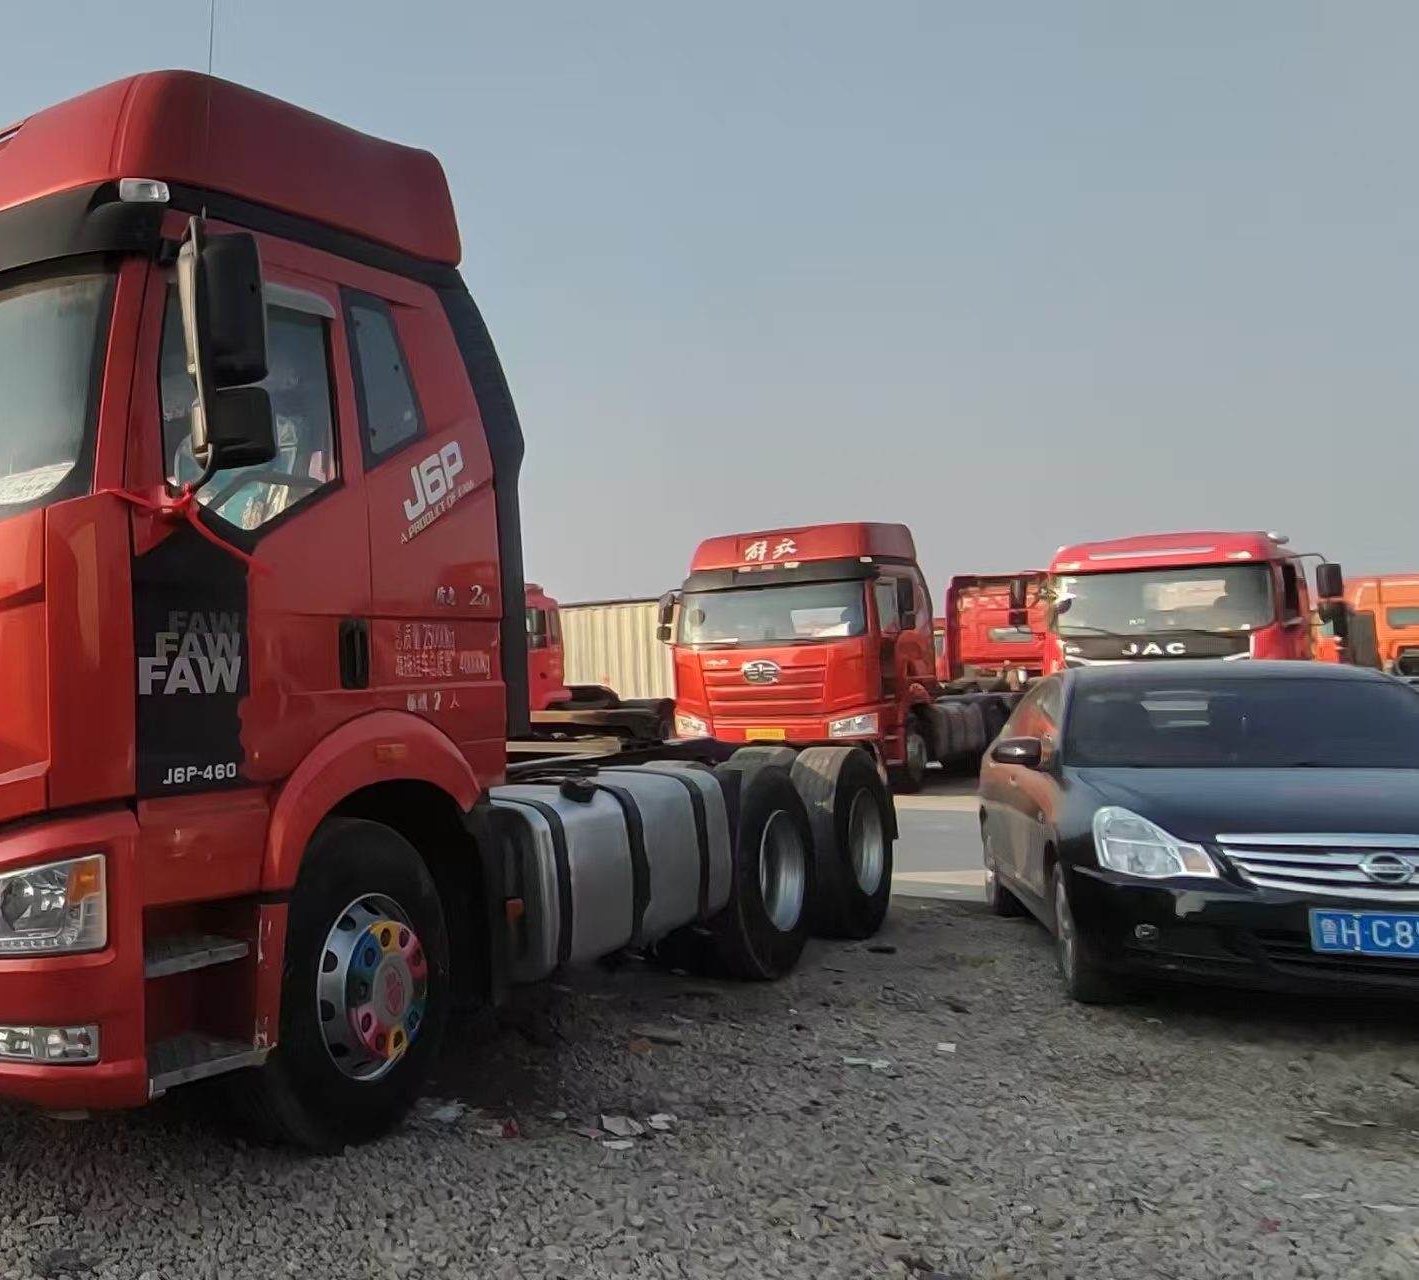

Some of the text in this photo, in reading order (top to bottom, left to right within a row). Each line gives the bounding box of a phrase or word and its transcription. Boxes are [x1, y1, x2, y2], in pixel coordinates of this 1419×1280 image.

[403, 440, 464, 521] J6P
[168, 610, 240, 637] FAW
[155, 631, 241, 660] FAW
[1121, 642, 1187, 656] JAC
[138, 656, 242, 696] FAW
[162, 762, 237, 785] J6P-460
